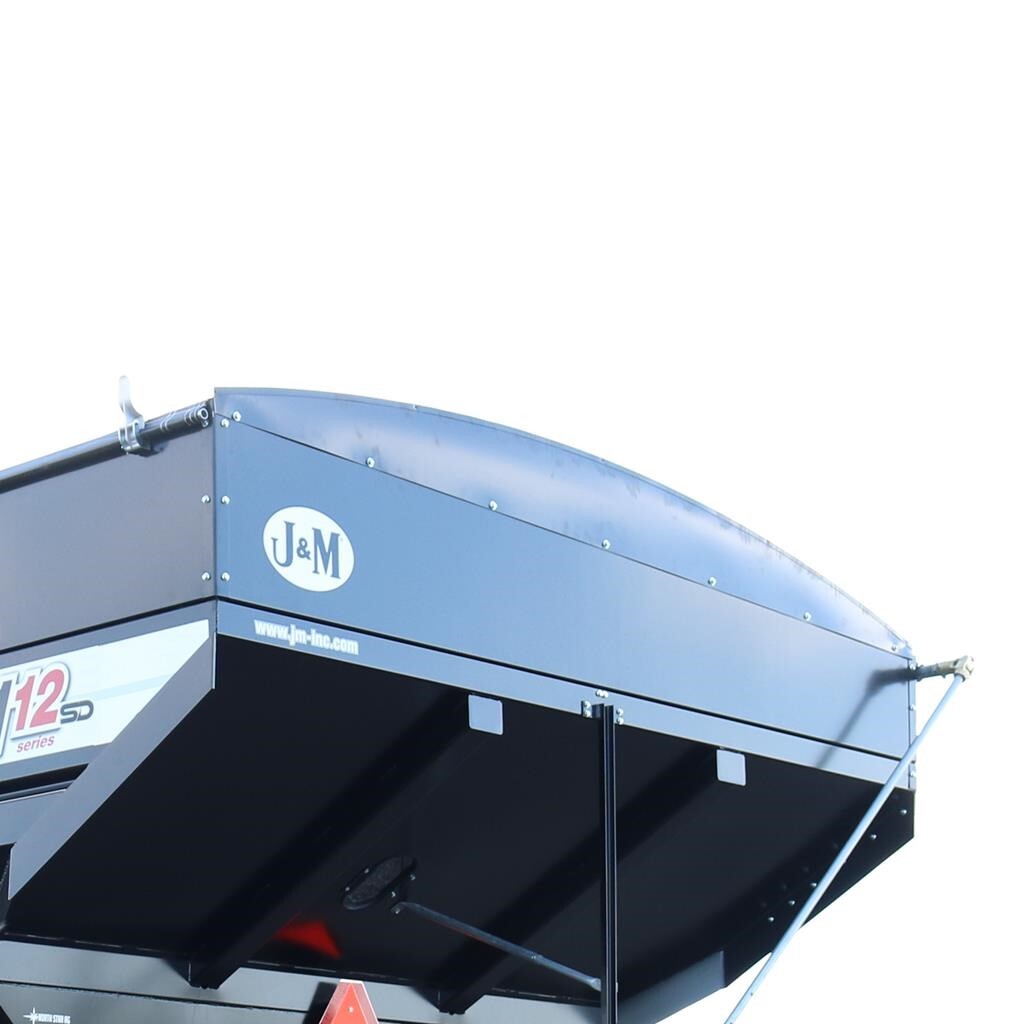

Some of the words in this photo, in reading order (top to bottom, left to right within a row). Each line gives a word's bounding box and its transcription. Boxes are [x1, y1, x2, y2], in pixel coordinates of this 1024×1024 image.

[271, 520, 341, 580] J&M
[253, 618, 360, 656] www.jm-inc.com
[60, 699, 95, 724] SD
[16, 734, 55, 753] series
